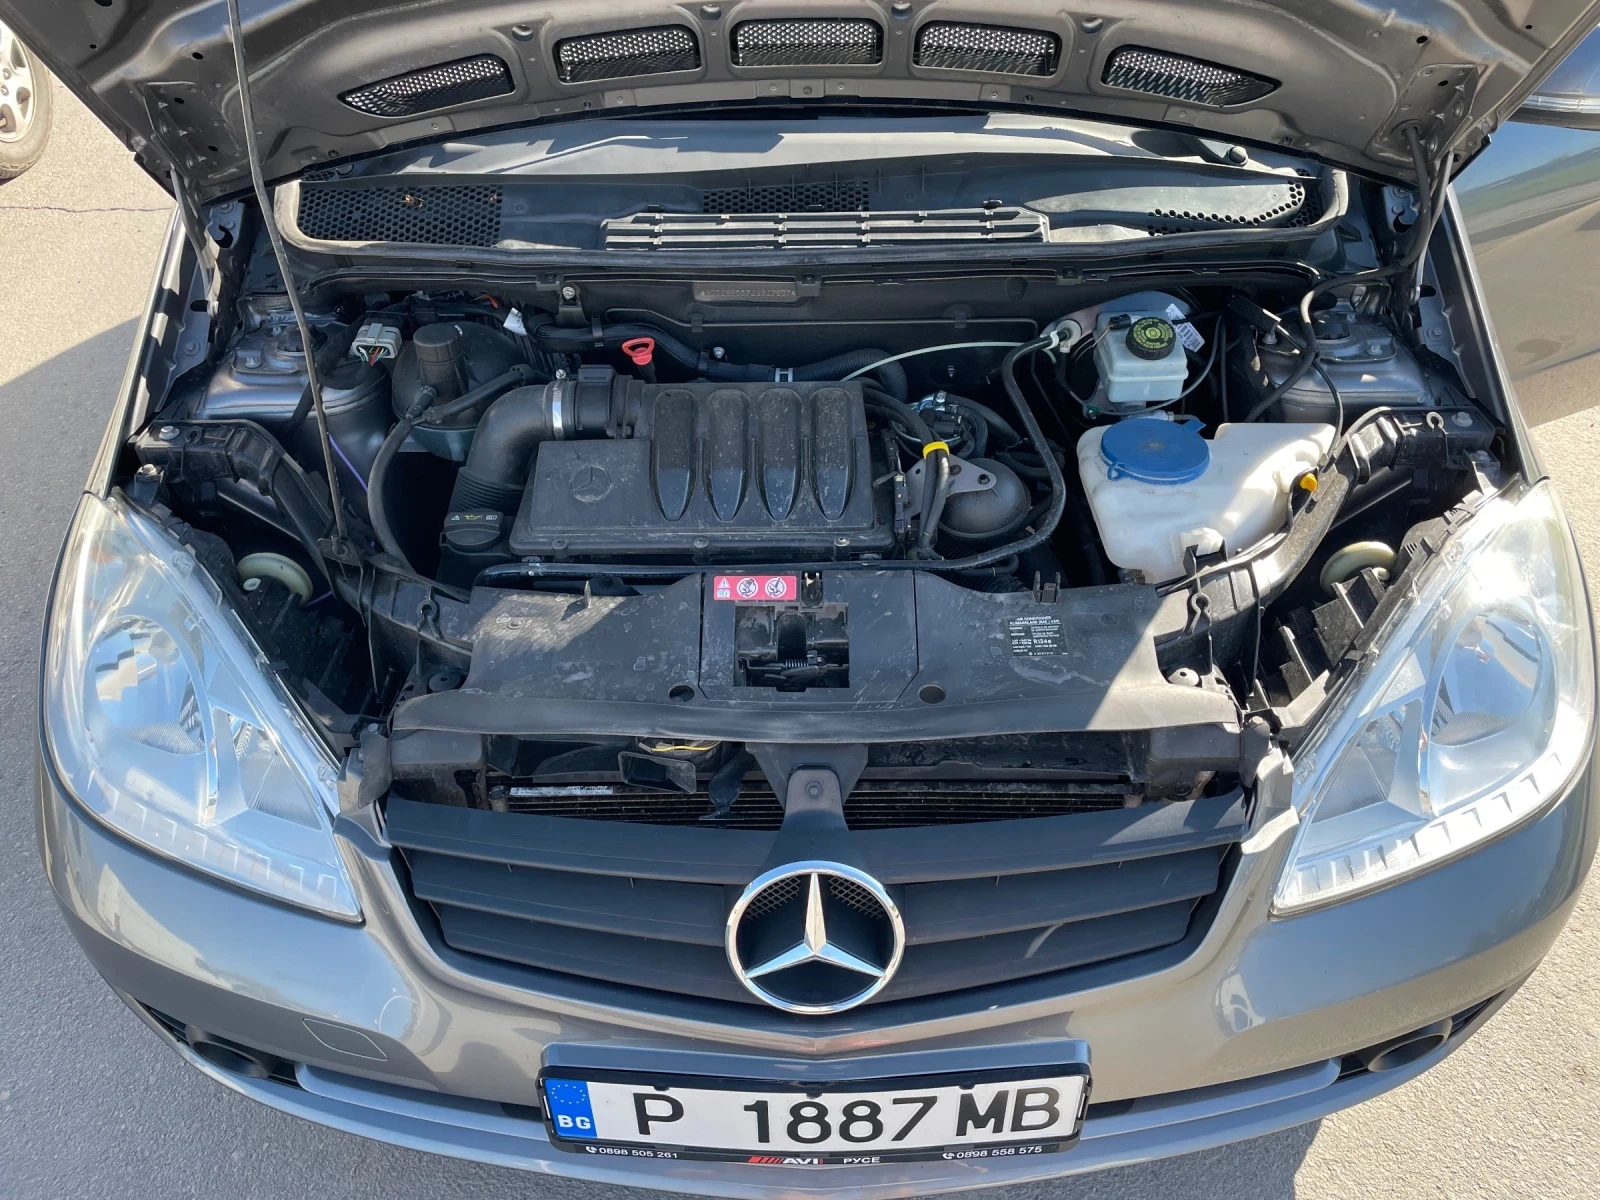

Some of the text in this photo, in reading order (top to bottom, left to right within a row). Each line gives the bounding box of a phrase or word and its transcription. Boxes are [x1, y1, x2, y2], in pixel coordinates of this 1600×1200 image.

[557, 1114, 591, 1130] BG
[632, 1087, 1060, 1145] P 1887 MB
[599, 1147, 678, 1159] 0898 505 261
[956, 1145, 1043, 1159] 0898 558 575
